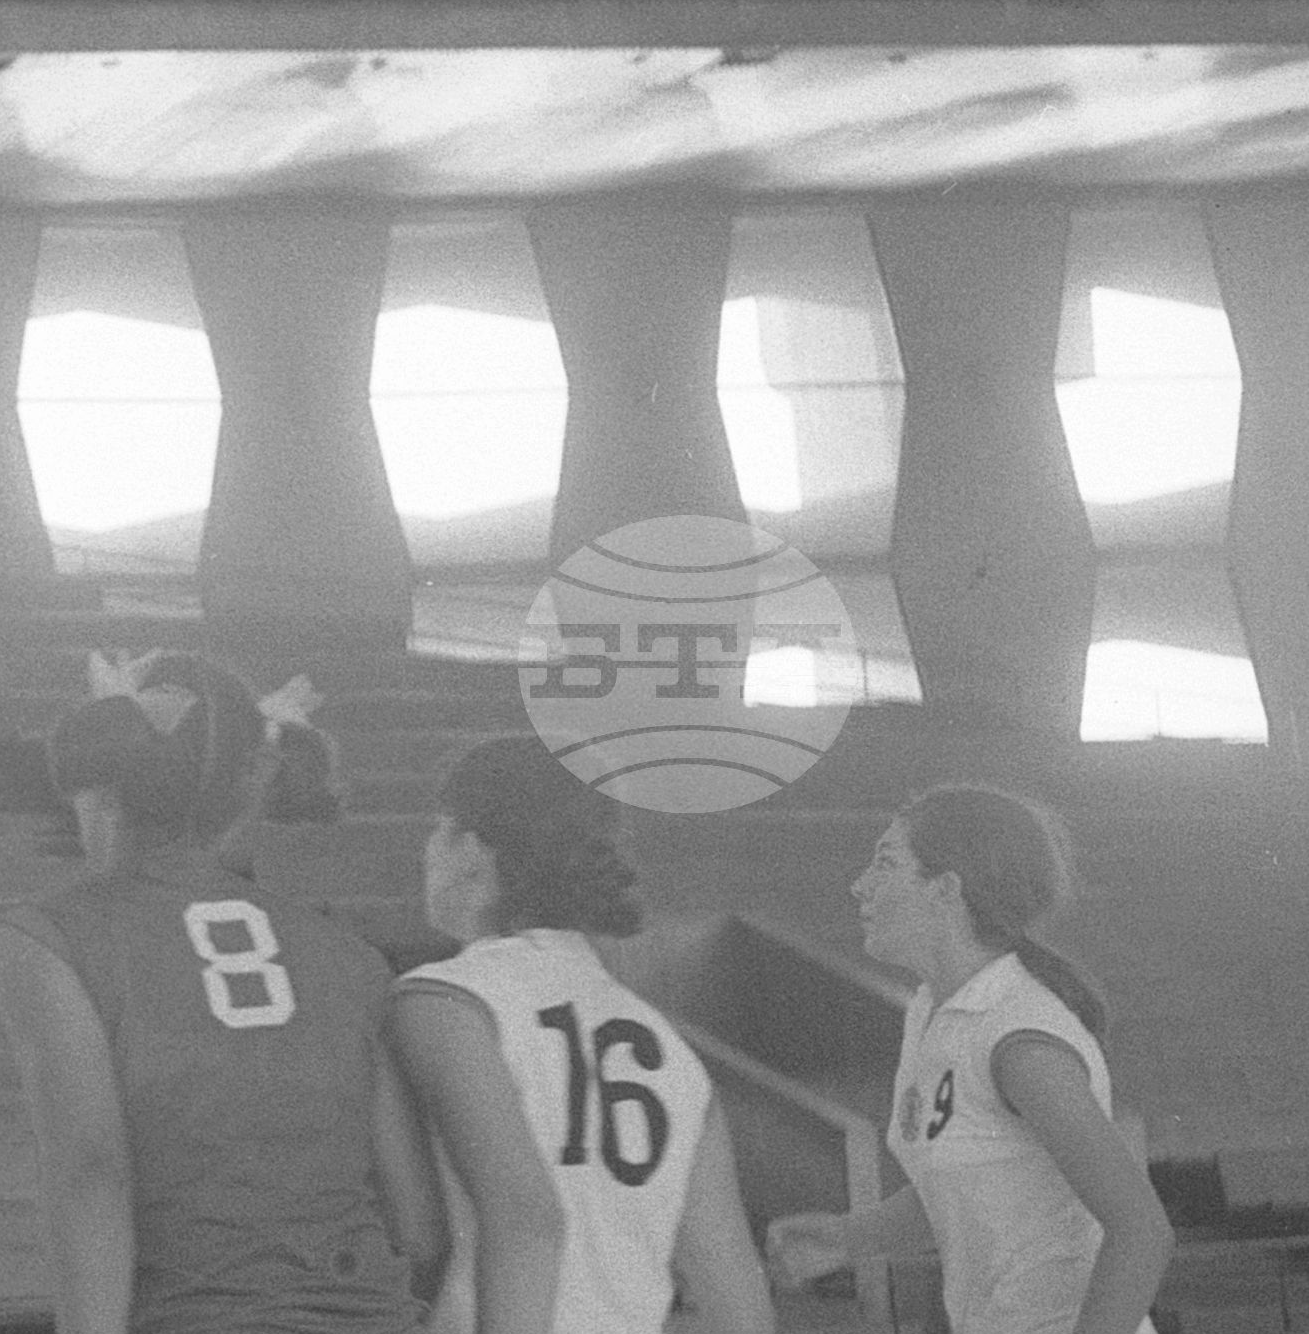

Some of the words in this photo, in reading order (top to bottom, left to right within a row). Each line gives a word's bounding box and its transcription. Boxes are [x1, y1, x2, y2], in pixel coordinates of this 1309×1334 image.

[184, 899, 296, 1028] 8
[537, 1000, 670, 1187] 16
[926, 1069, 954, 1141] 9
